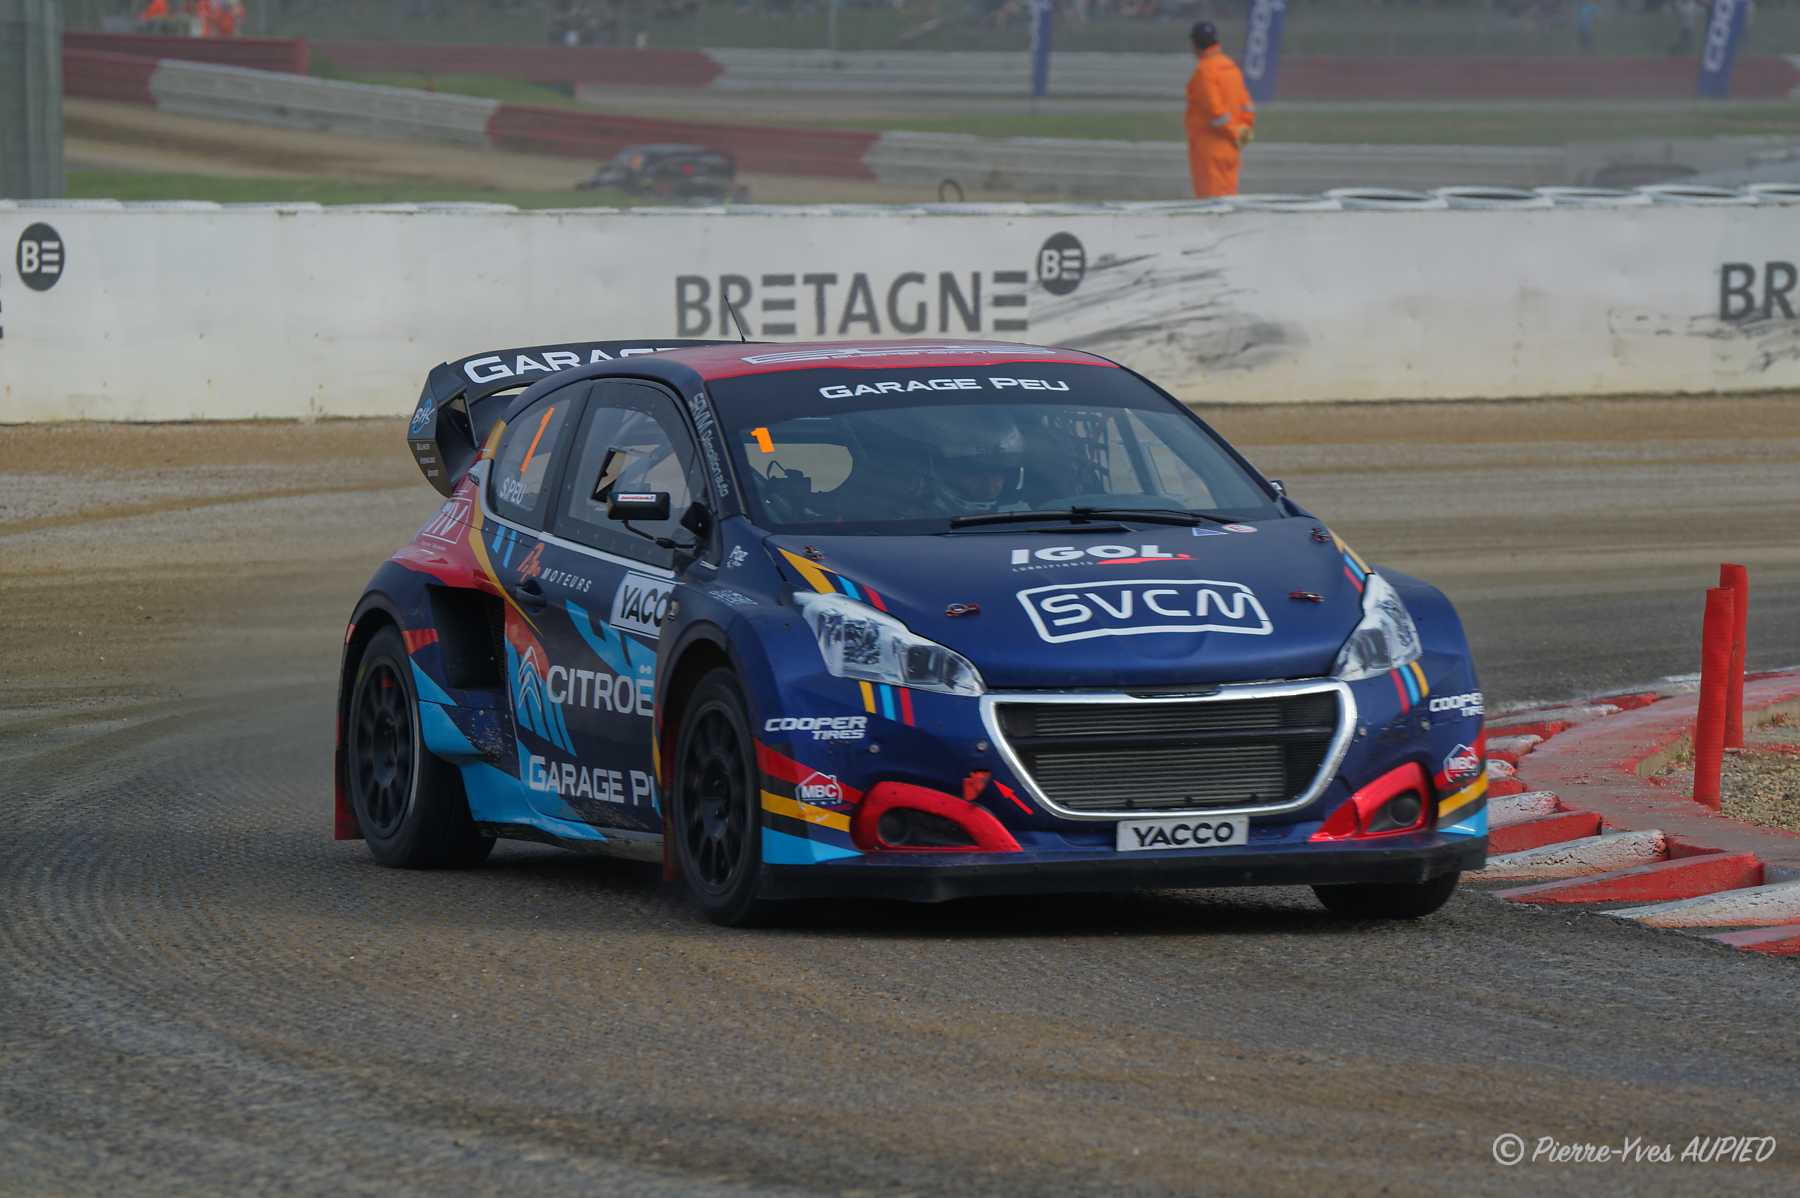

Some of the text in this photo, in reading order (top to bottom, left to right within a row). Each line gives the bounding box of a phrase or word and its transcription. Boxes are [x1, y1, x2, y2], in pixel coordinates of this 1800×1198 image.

[22, 240, 60, 273] BE
[1040, 248, 1083, 279] BE
[675, 271, 1029, 338] BRETAGNE
[819, 376, 1070, 399] GARAGE PEU
[751, 427, 775, 453] 1
[541, 567, 592, 593] MOTEURS
[1041, 589, 1256, 626] SVCM
[764, 716, 868, 732] COOPER
[812, 729, 866, 740] TIRES
[528, 754, 625, 804] GARAGE
[800, 783, 838, 799] MBC
[1132, 821, 1234, 847] YACCO
